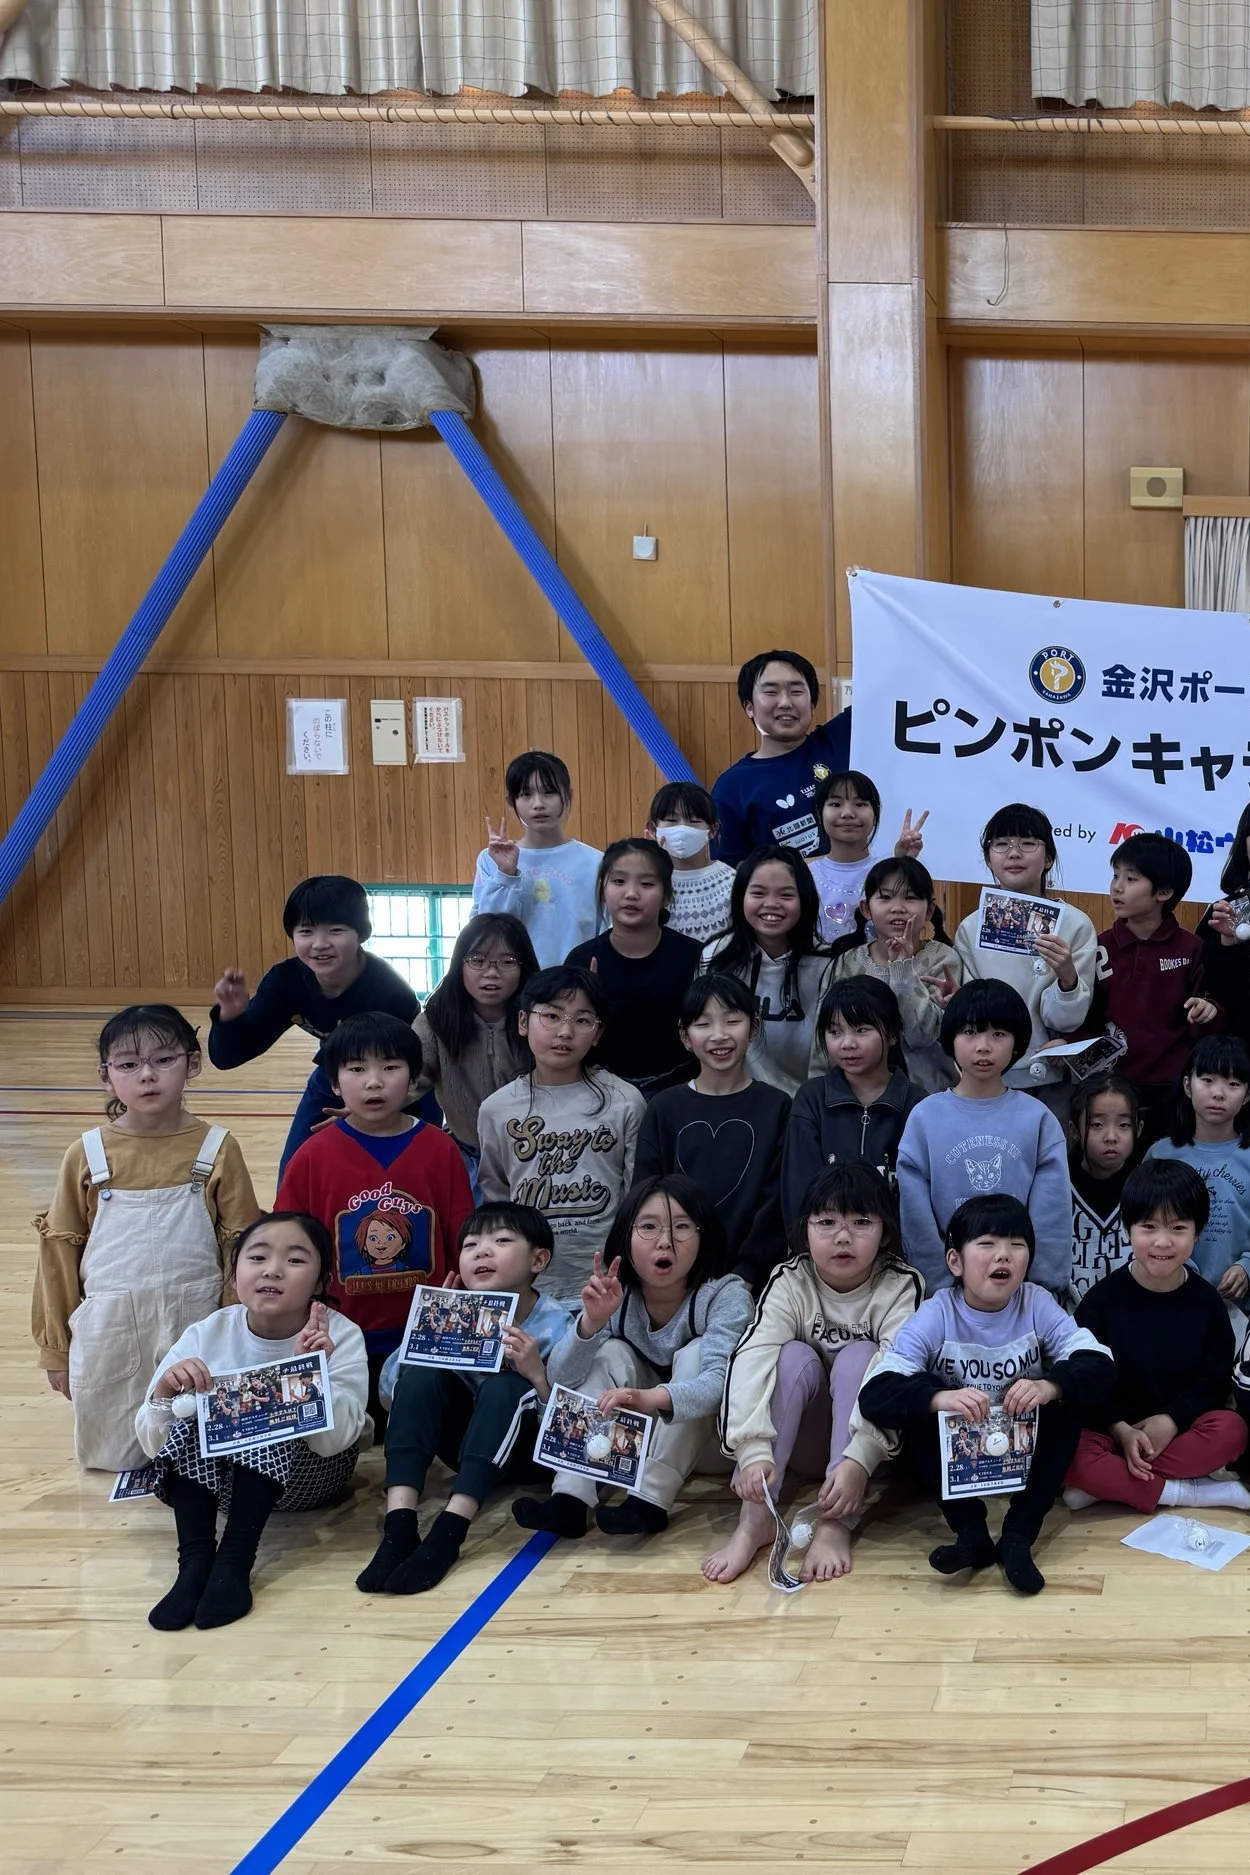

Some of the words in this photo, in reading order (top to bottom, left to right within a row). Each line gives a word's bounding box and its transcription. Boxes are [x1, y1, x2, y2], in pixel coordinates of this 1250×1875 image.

[1041, 648, 1075, 662] PORT
[302, 731, 312, 763] ください。
[312, 717, 322, 760] のぼらないで
[1078, 824, 1096, 843] by
[507, 1115, 592, 1162] Sway
[590, 1124, 617, 1153] to
[945, 1135, 1008, 1165] CUTENESS
[538, 1149, 578, 1176] the
[514, 1174, 608, 1210] Music
[1213, 1163, 1248, 1196] cherries
[348, 1182, 393, 1211] Good
[378, 1197, 423, 1215] Guys
[960, 1359, 990, 1379] YOU
[993, 1359, 1017, 1380] SO
[1018, 1346, 1039, 1372] MU
[206, 1423, 224, 1432] 2.28
[949, 1464, 964, 1472] 2.28
[949, 1475, 960, 1483] 3.1
